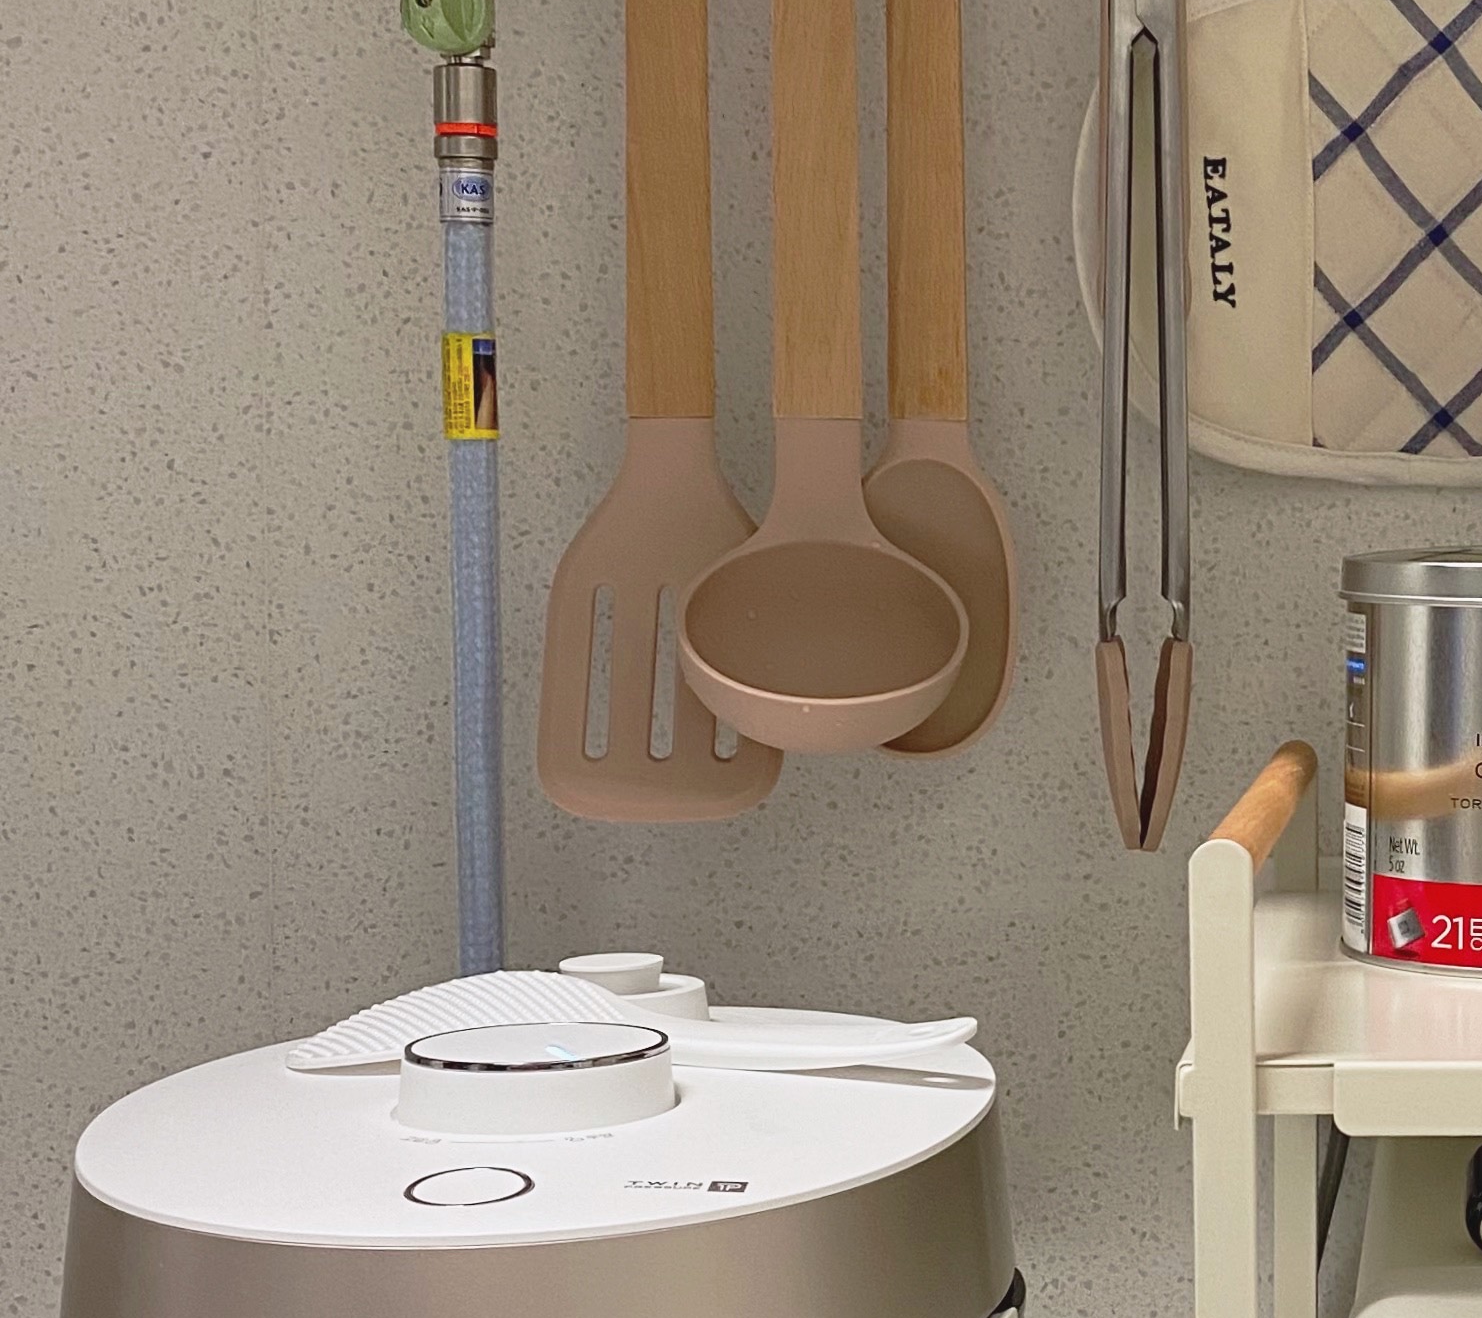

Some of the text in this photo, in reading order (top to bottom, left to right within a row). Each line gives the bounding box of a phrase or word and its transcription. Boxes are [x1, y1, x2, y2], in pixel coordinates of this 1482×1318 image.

[461, 183, 487, 195] KAS
[1203, 155, 1237, 309] EATALY
[1430, 914, 1464, 951] 21
